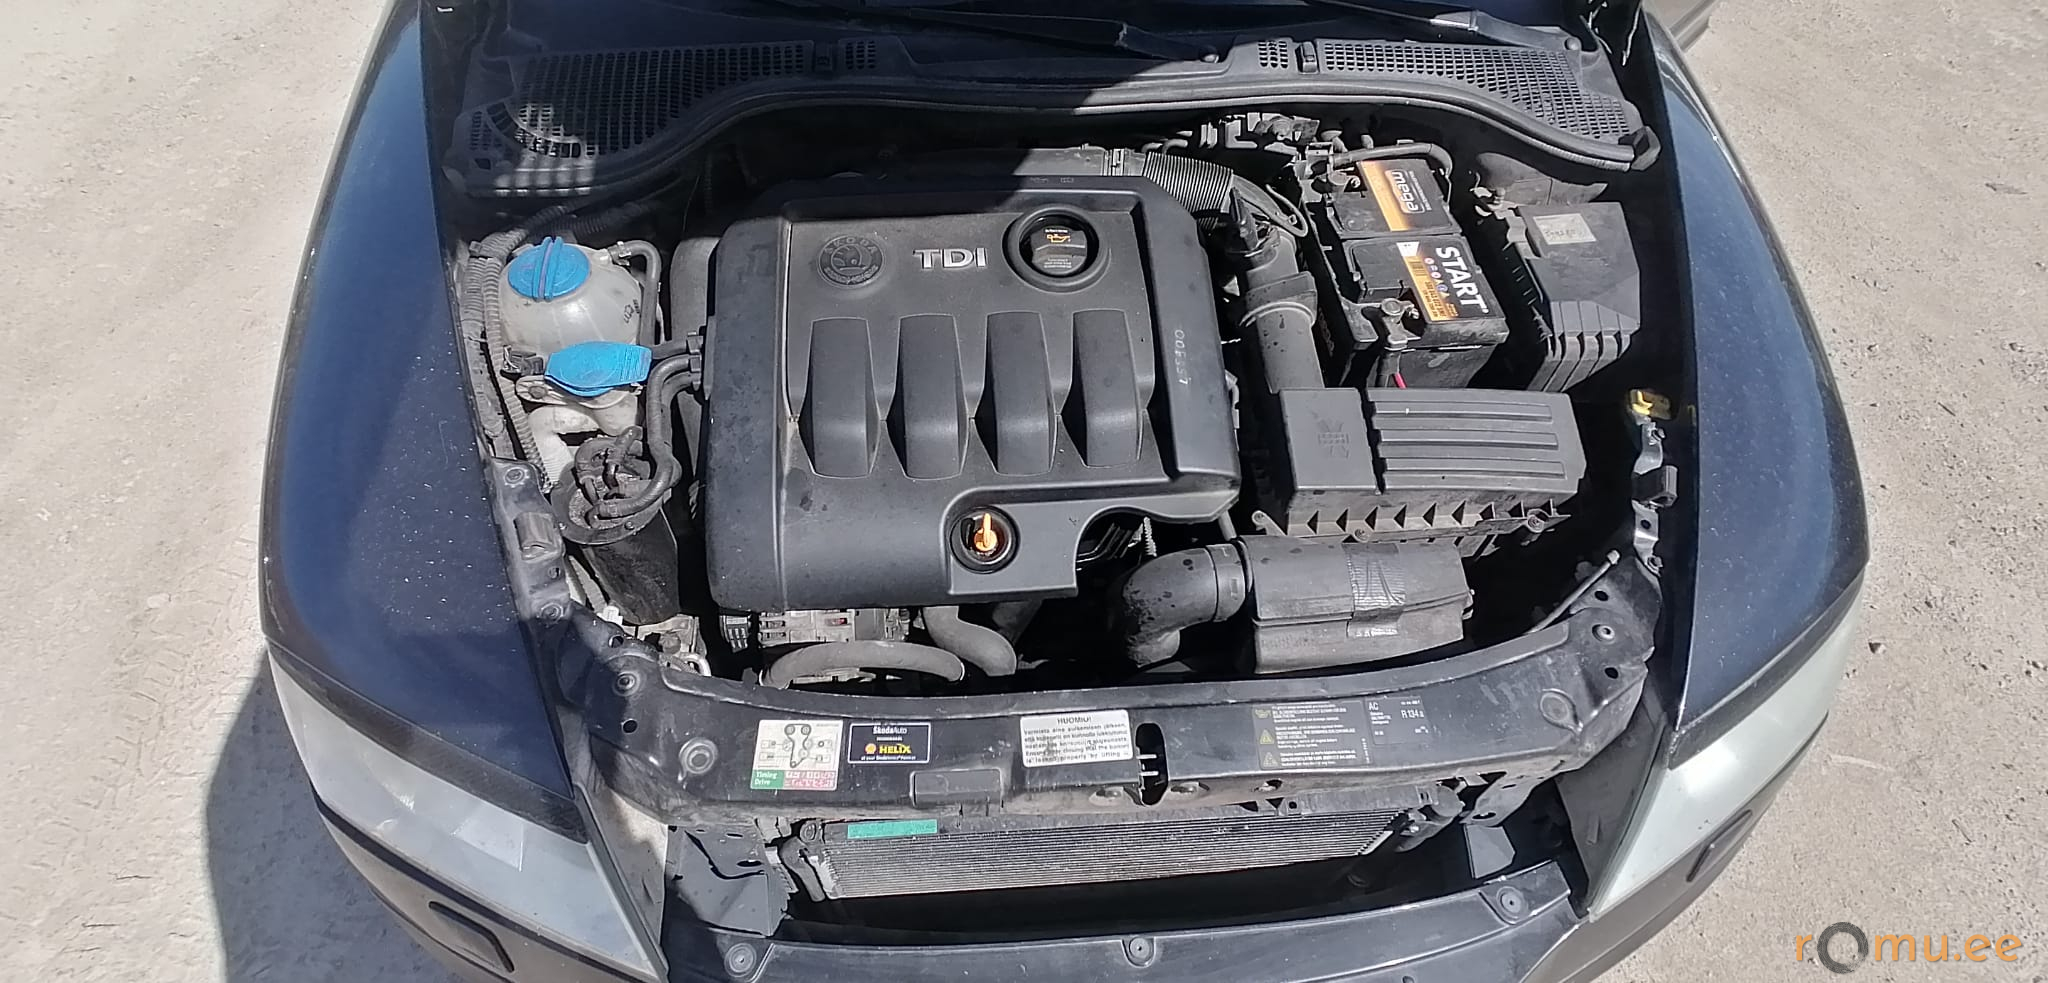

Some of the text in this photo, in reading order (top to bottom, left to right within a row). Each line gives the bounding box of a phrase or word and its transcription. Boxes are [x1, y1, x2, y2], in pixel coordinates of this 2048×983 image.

[1391, 170, 1419, 211] mega
[913, 248, 986, 269] TDI
[1435, 246, 1486, 311] START
[1368, 702, 1379, 710] AC
[879, 742, 912, 754] HELIX
[755, 771, 778, 779] Timing
